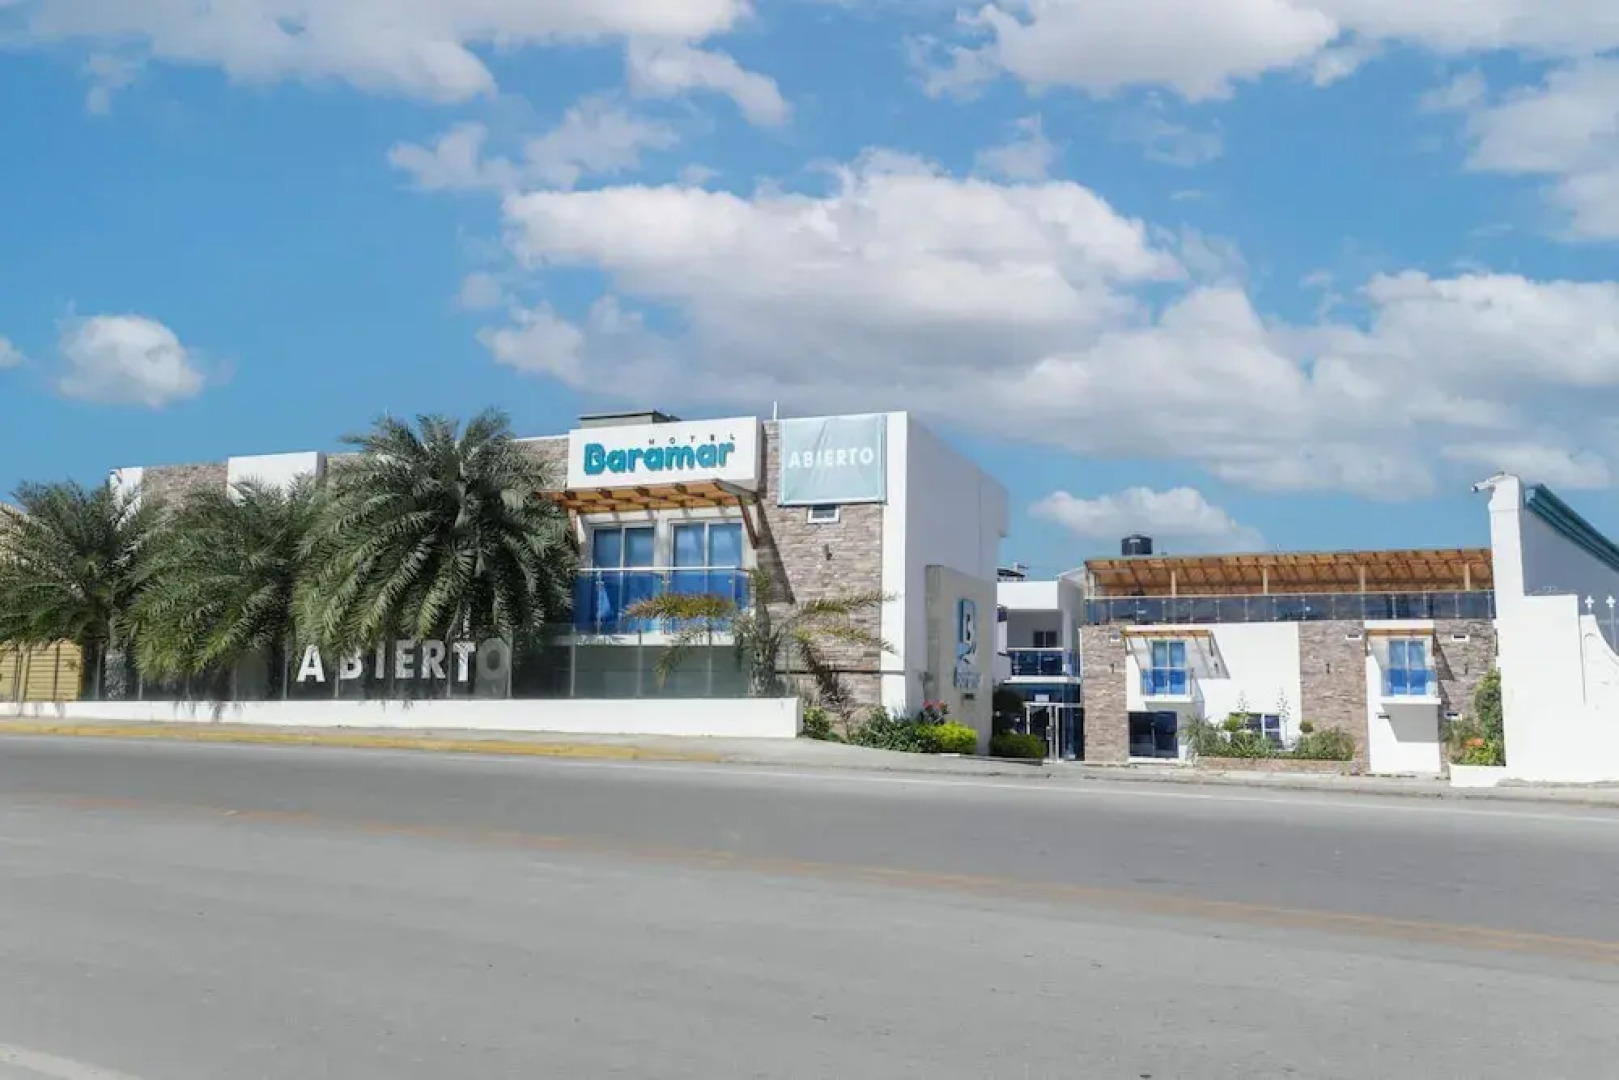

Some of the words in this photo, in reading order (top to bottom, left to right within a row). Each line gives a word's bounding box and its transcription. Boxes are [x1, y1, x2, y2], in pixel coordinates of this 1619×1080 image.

[648, 433, 735, 445] HOTEL
[583, 441, 735, 475] Baramar
[788, 447, 875, 469] ABIERTO
[296, 638, 510, 683] ABIERTO
